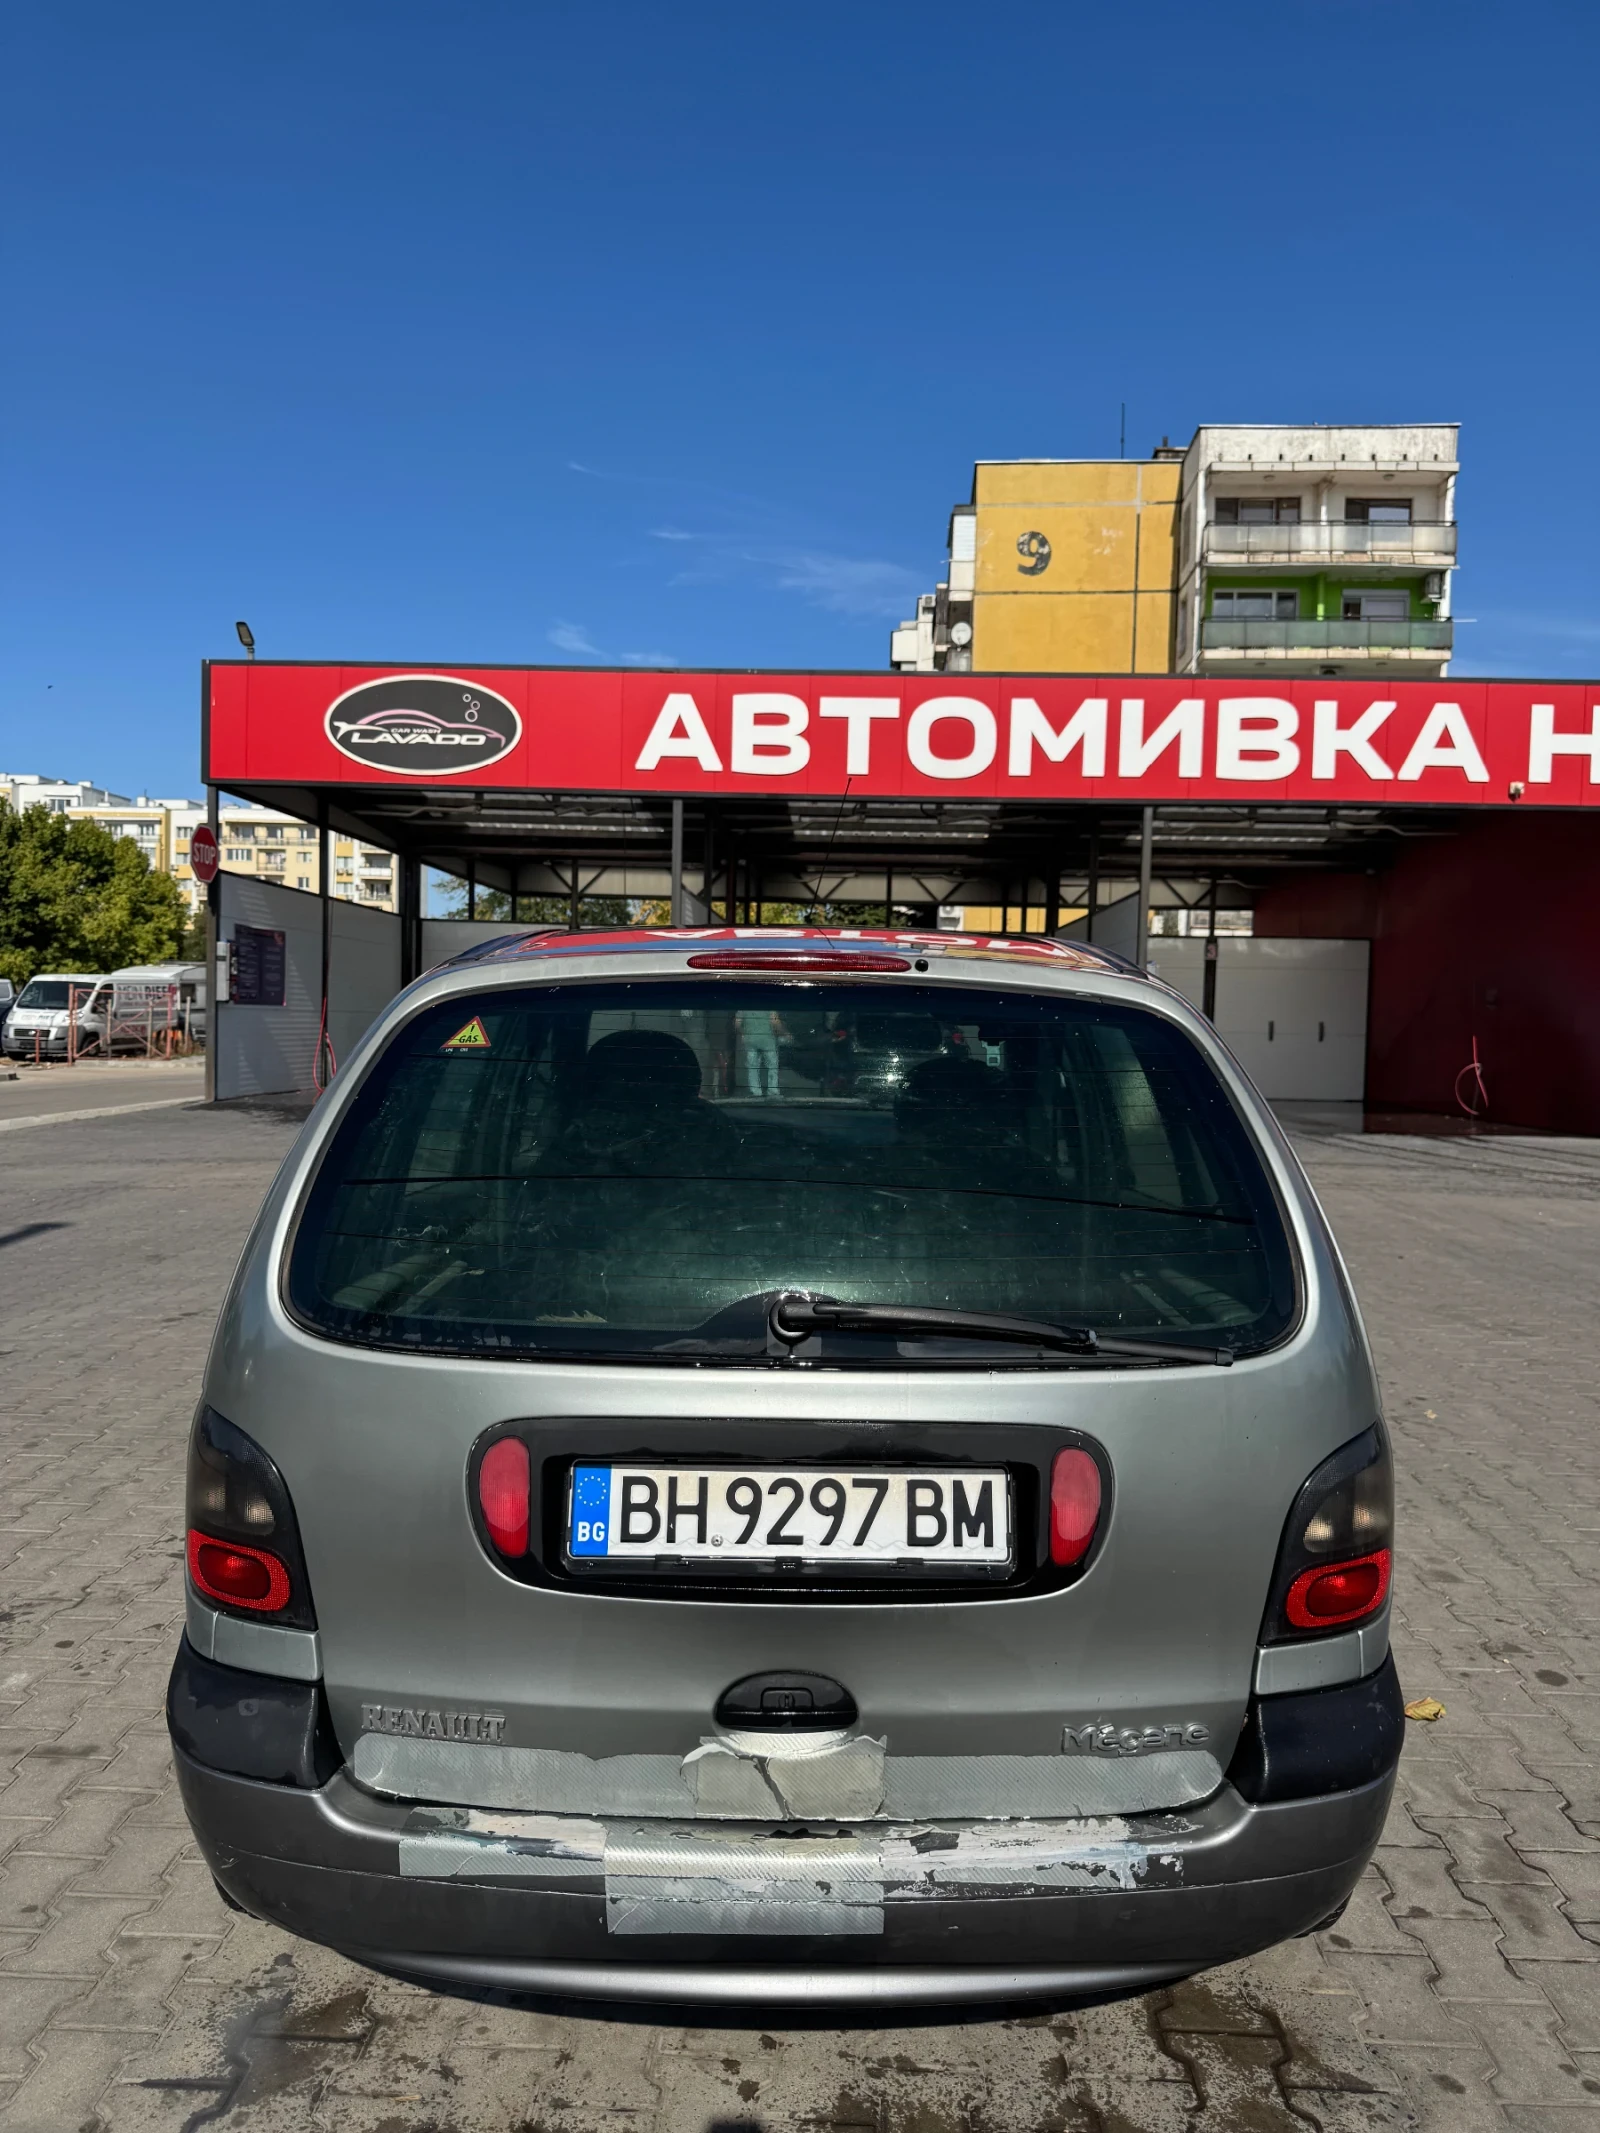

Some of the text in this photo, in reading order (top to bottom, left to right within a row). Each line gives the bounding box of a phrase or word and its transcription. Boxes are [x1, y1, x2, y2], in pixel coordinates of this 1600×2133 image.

[1016, 530, 1052, 577] 9
[351, 732, 486, 745] LAVADO
[635, 693, 1490, 783] АВТОМИВКА
[193, 842, 216, 867] STOP
[458, 1035, 478, 1043] GAS
[620, 1475, 994, 1548] BH 9297 BM
[577, 1520, 606, 1542] BG
[361, 1703, 506, 1742] RENAULT
